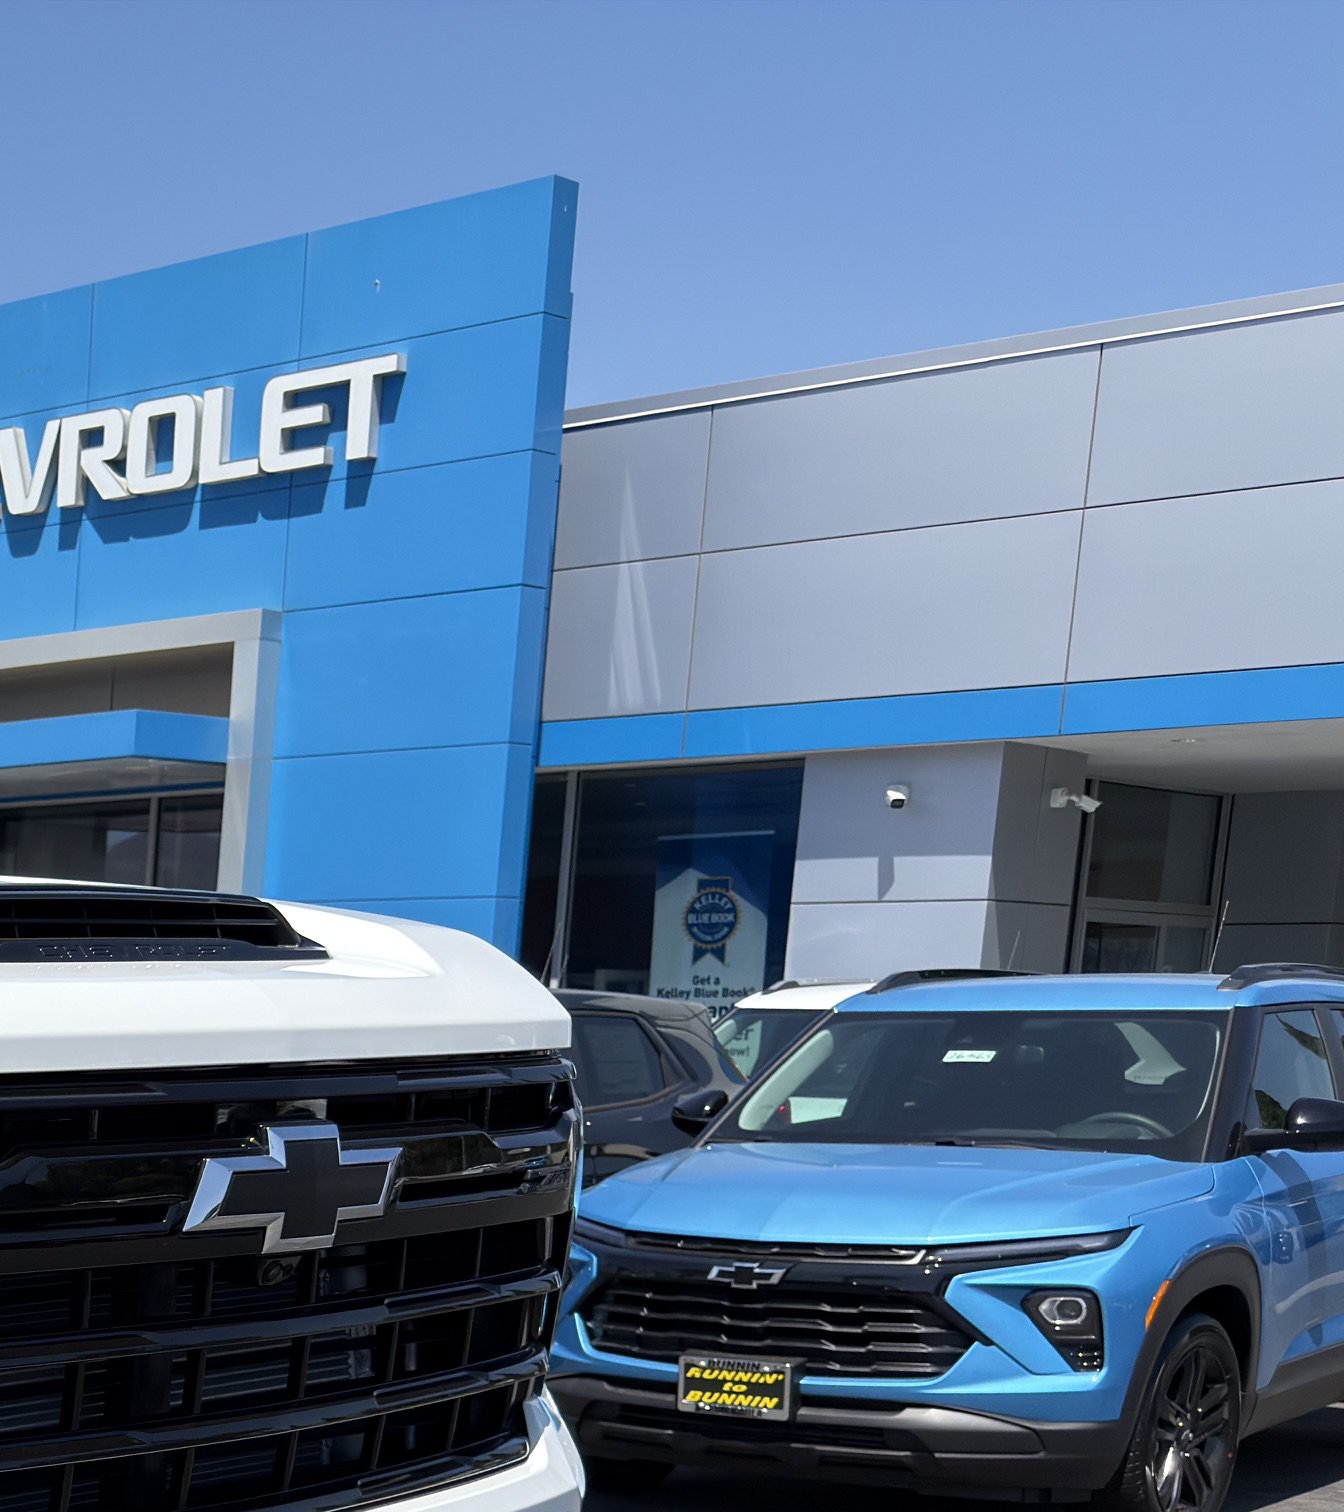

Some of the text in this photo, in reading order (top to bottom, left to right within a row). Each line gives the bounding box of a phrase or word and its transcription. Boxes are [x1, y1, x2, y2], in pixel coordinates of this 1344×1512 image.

[694, 893, 732, 910] KELLEY
[688, 912, 736, 924] BLUE BOOK
[692, 975, 720, 985] Get a
[657, 988, 691, 1000] Kelley
[694, 988, 718, 998] Blue
[686, 1367, 784, 1384] RUNNIN'
[722, 1382, 748, 1392] to
[685, 1390, 779, 1409] BUNNIN
